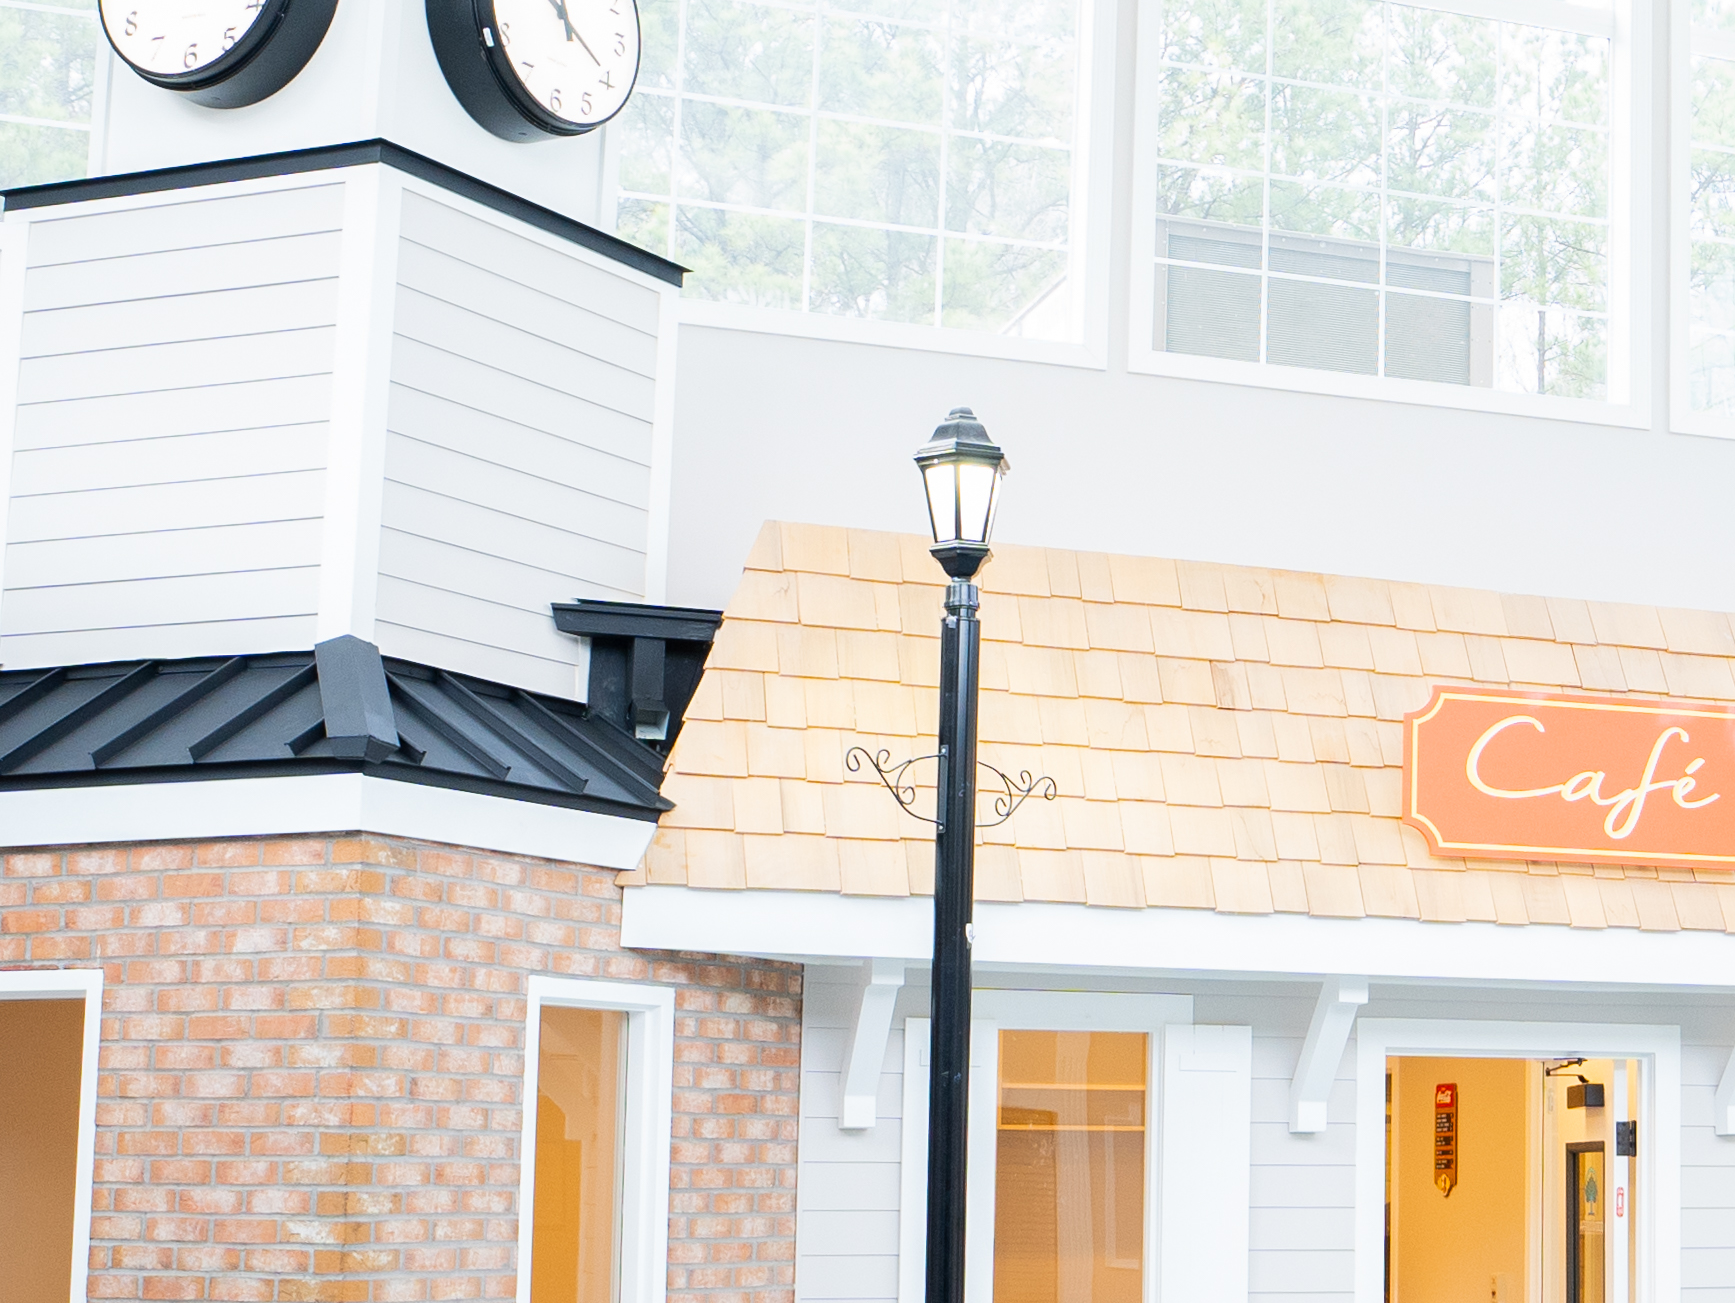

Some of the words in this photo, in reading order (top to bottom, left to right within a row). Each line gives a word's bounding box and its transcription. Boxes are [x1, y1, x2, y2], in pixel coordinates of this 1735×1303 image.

[124, 10, 138, 36] 8
[499, 22, 511, 48] 8
[150, 35, 165, 61] 7
[222, 26, 237, 52] 5
[614, 32, 626, 57] 3
[183, 43, 198, 69] 6
[598, 70, 616, 91] 4
[550, 88, 562, 113] 6
[580, 91, 593, 116] 5
[1465, 714, 1721, 839] Café
